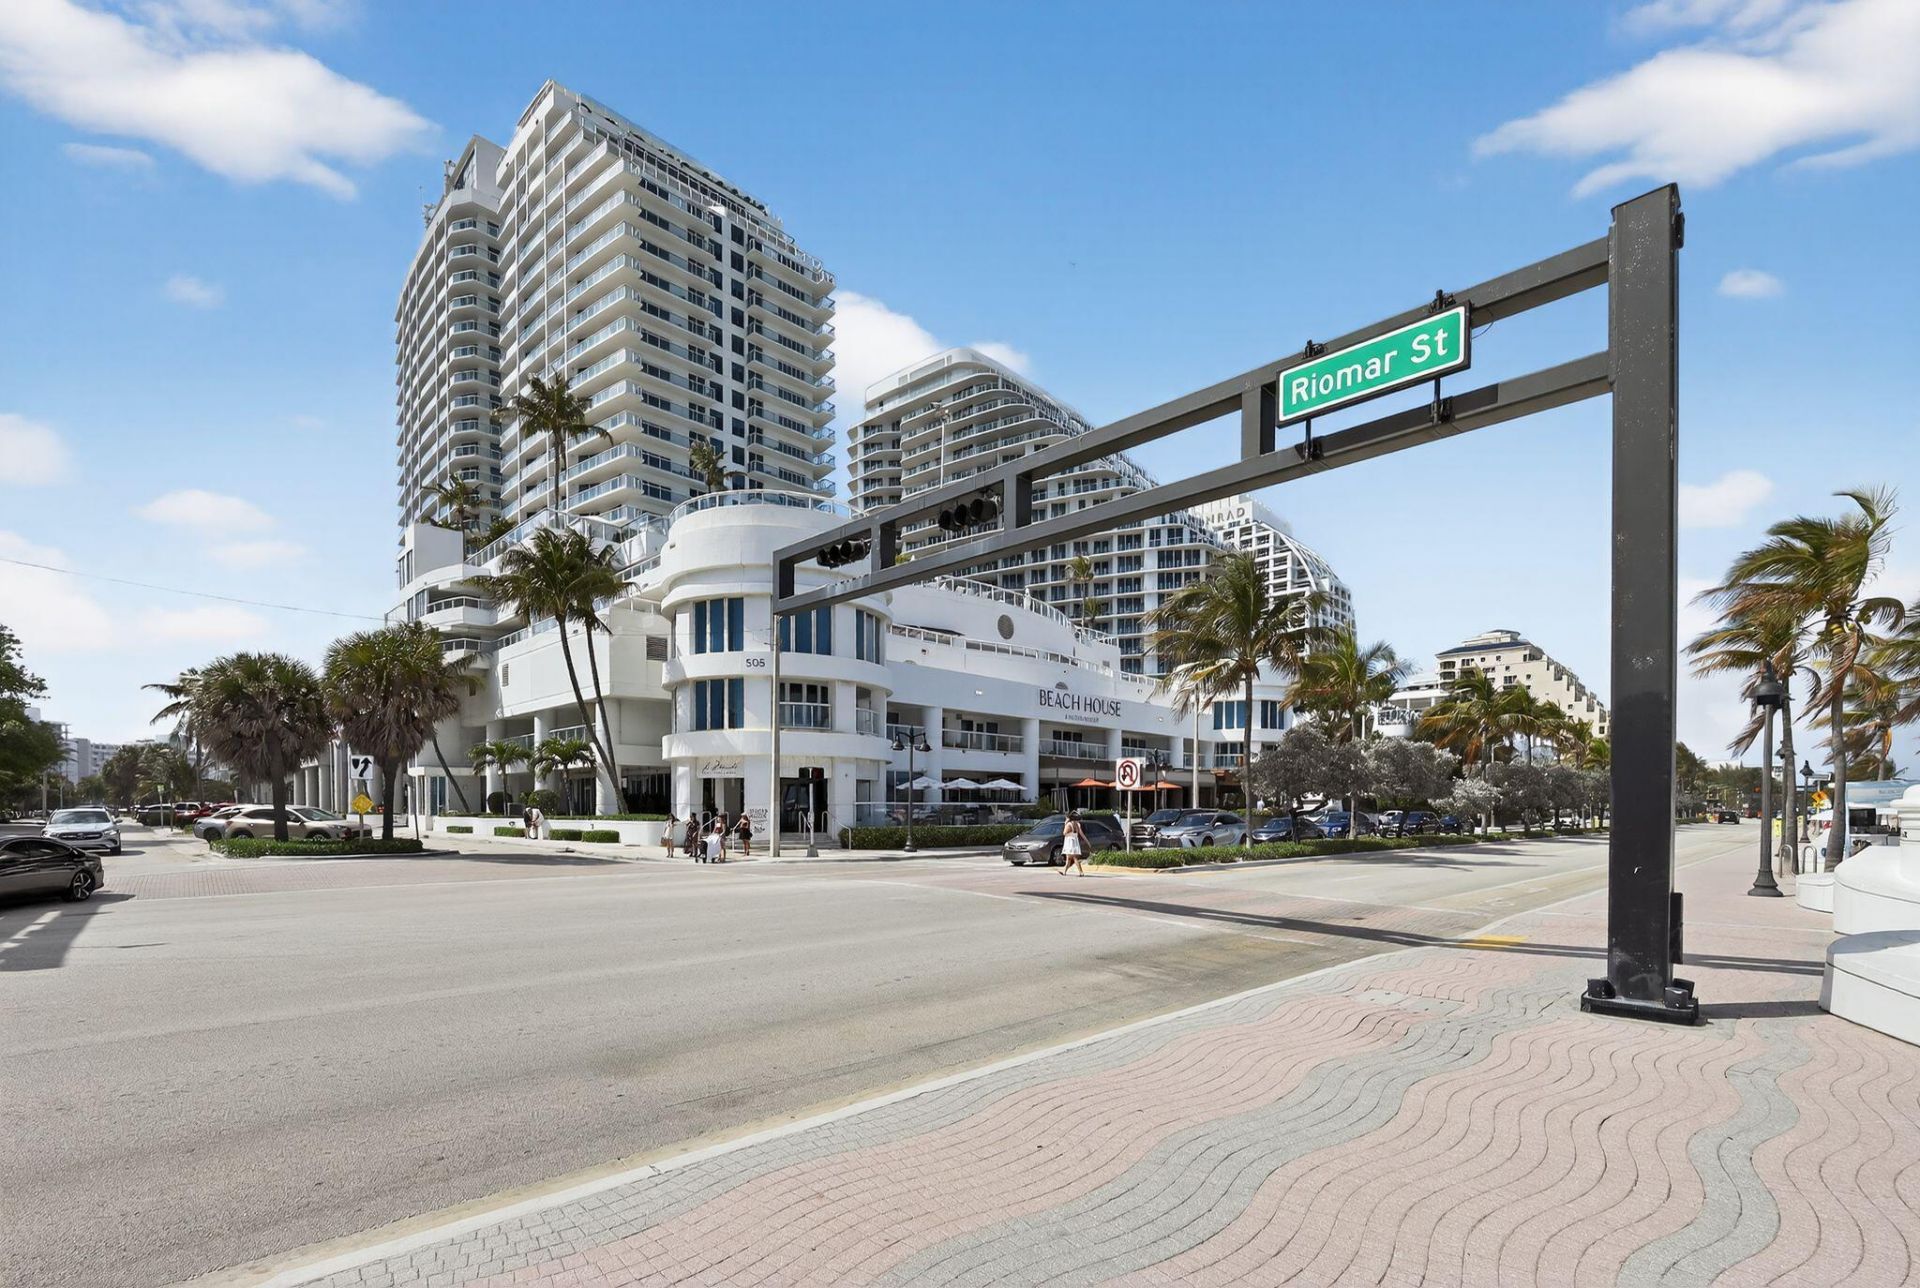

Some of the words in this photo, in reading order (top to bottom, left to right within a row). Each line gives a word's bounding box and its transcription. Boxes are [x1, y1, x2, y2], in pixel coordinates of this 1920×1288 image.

[1292, 350, 1398, 405] Riomar
[1410, 328, 1448, 364] St
[1206, 507, 1245, 525] NRAD
[746, 658, 766, 668] 505
[1039, 689, 1080, 711] BEACH
[1083, 696, 1121, 717] HOUSE
